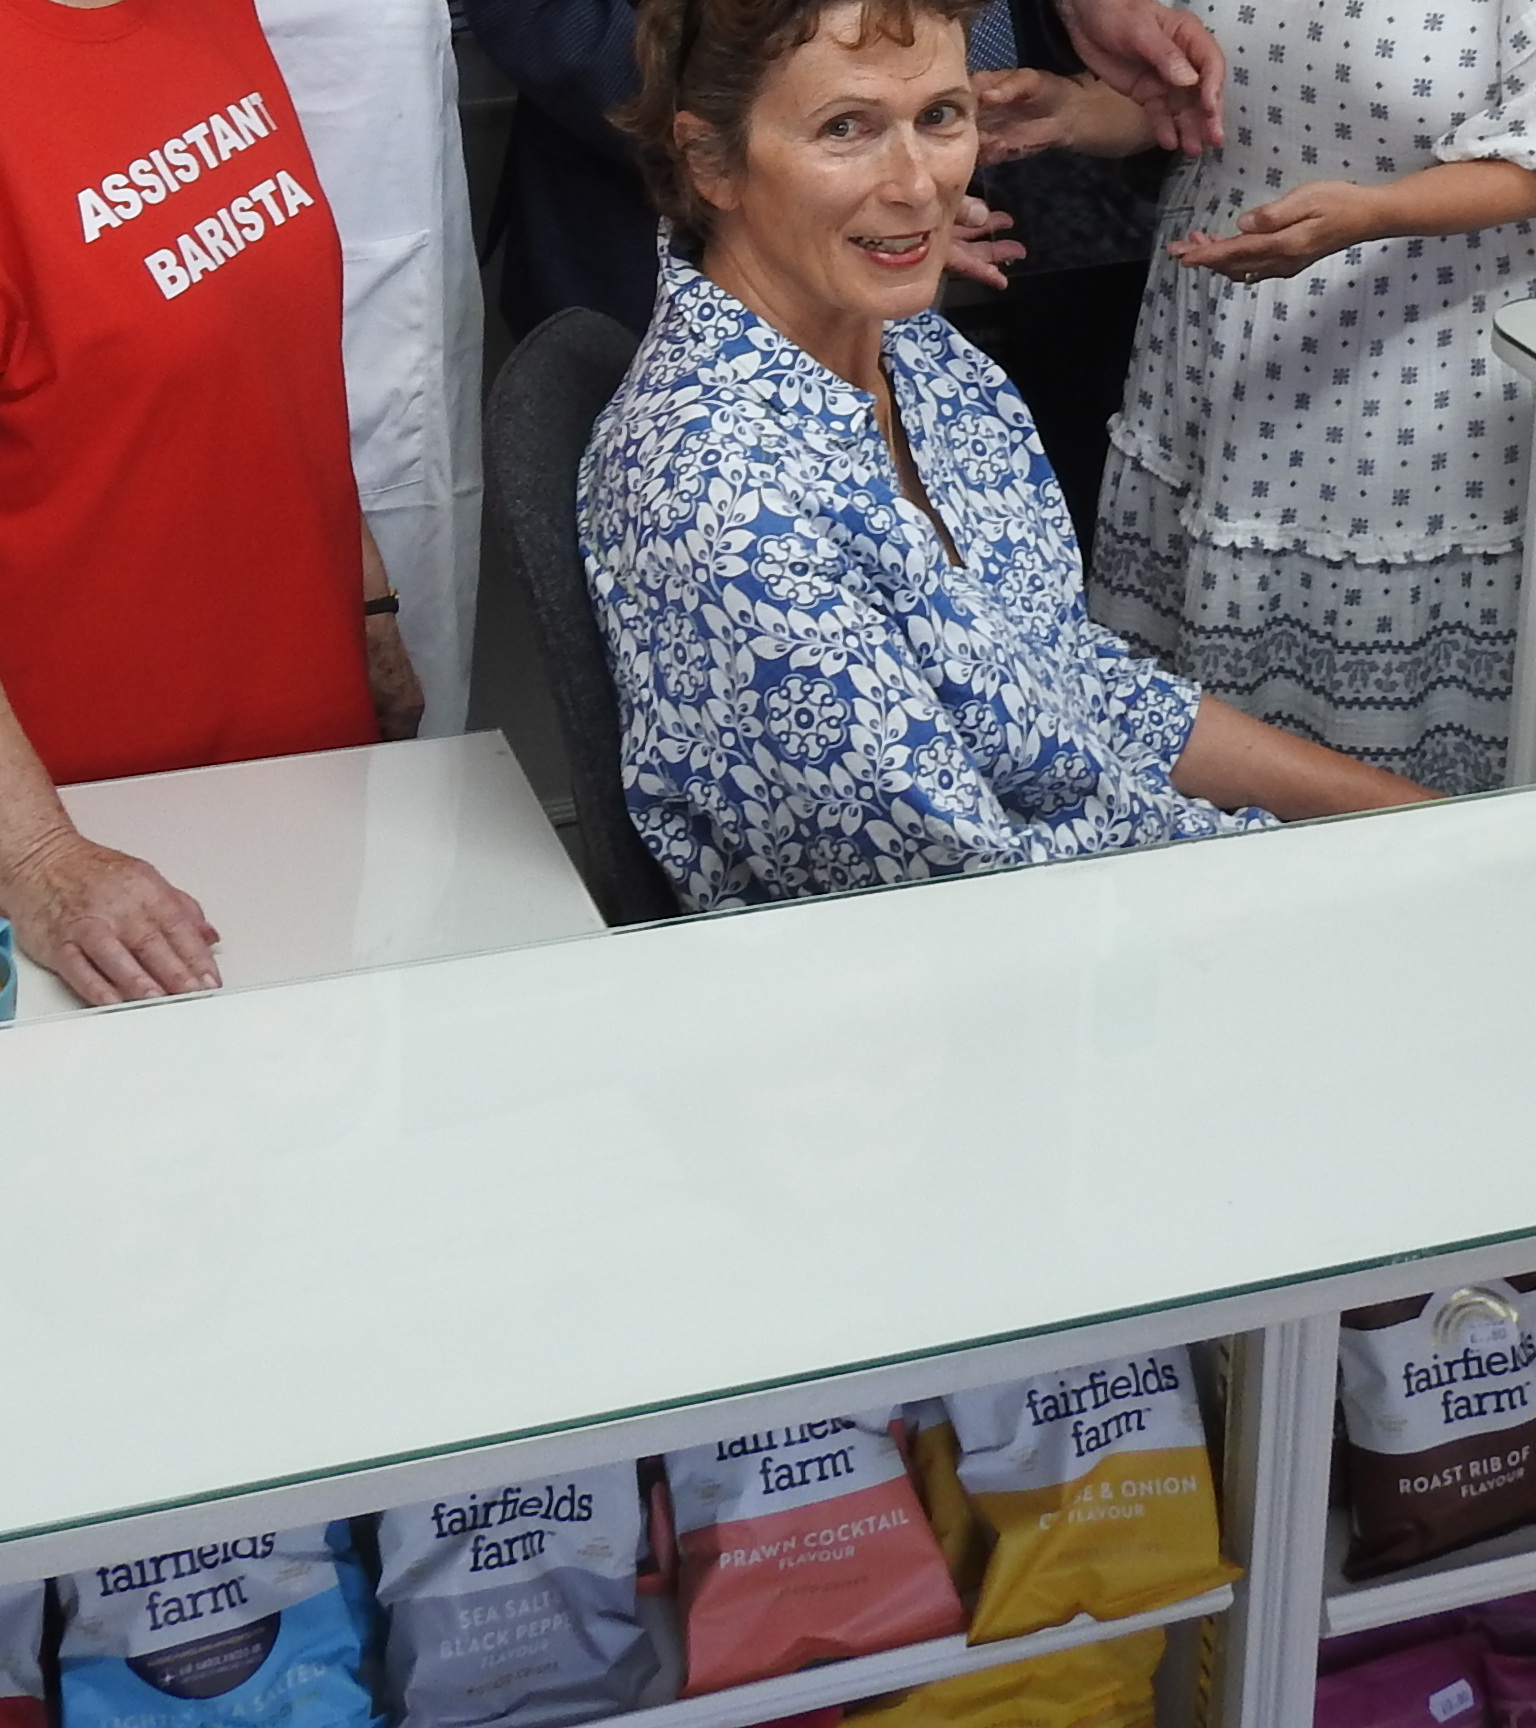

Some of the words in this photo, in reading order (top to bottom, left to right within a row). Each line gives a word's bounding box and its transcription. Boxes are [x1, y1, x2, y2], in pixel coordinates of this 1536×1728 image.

[75, 90, 279, 244] ASSISTANT
[143, 169, 314, 301] BARISTA
[1026, 1357, 1180, 1427] fairfields
[1441, 1383, 1528, 1424] farm
[1071, 1408, 1146, 1458] farm
[759, 1447, 855, 1495] farm
[1121, 1475, 1198, 1498] ONION
[1398, 1464, 1464, 1495] ROAST
[1468, 1455, 1503, 1479] RIB
[1506, 1444, 1531, 1468] OF
[1461, 1467, 1526, 1499] FLAVOUR
[430, 1483, 594, 1539] fairfields
[469, 1528, 546, 1572] farm
[719, 1535, 797, 1570] PRAWN
[803, 1508, 910, 1548] COCKTAIL
[777, 1545, 856, 1570] FLAVOUR
[144, 1576, 248, 1632] farm
[458, 1604, 500, 1630] SEA
[504, 1590, 551, 1619] SALT
[438, 1628, 510, 1659] BLACK
